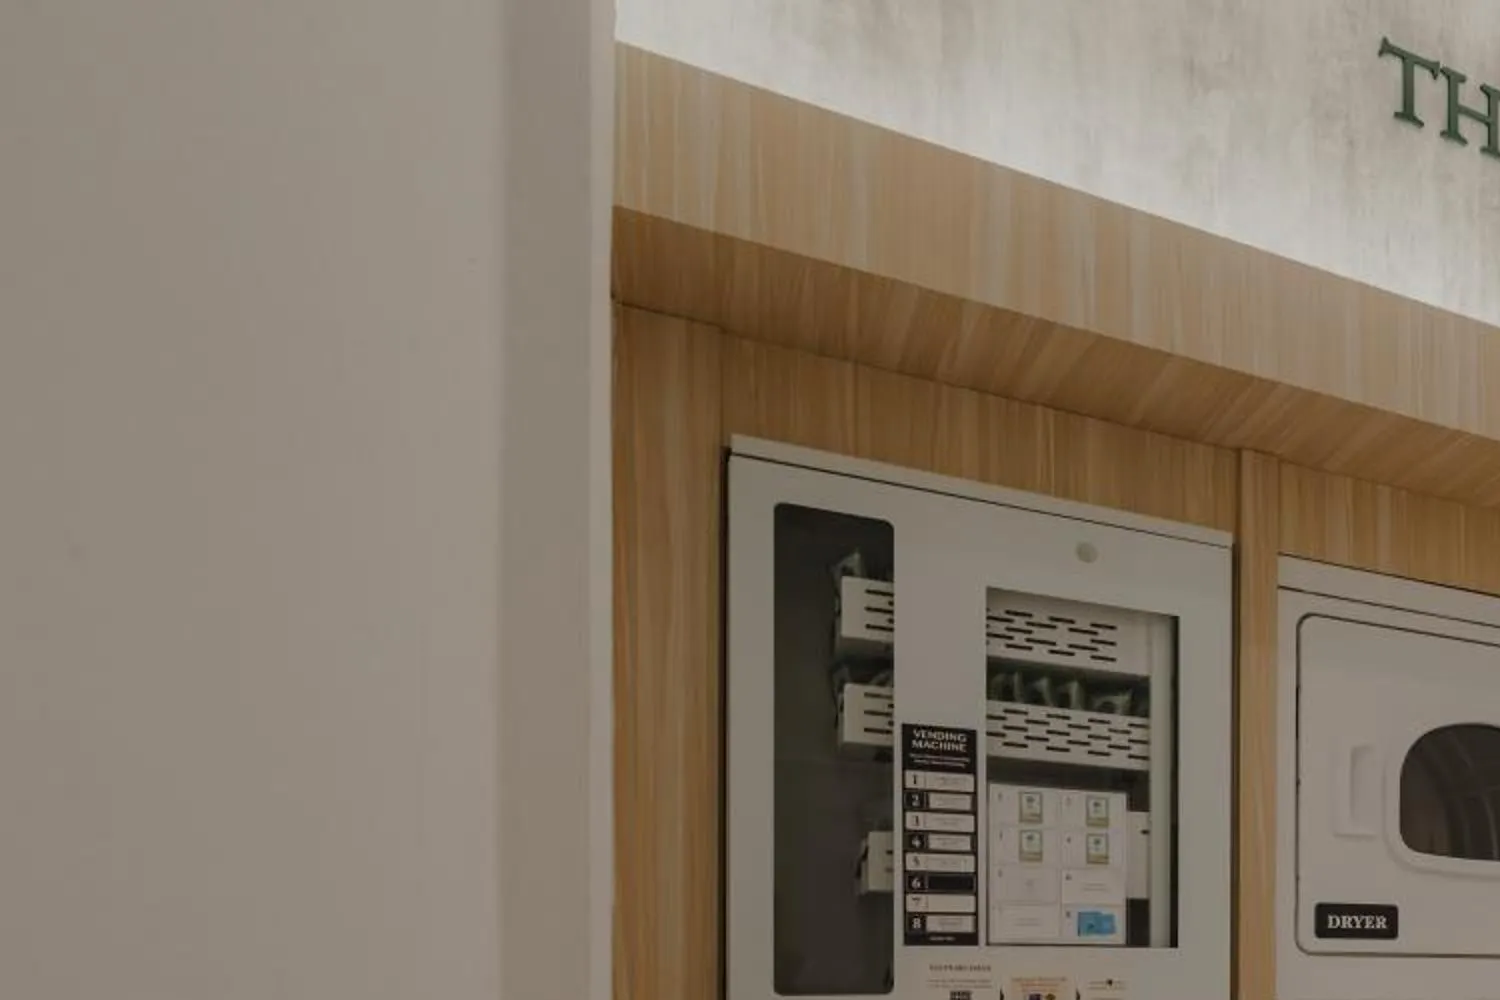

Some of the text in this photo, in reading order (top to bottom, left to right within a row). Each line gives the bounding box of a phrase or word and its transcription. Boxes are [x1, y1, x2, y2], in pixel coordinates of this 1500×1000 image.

[912, 728, 968, 743] VENDING
[911, 739, 968, 752] MACHINE
[1327, 914, 1388, 929] DRYER
